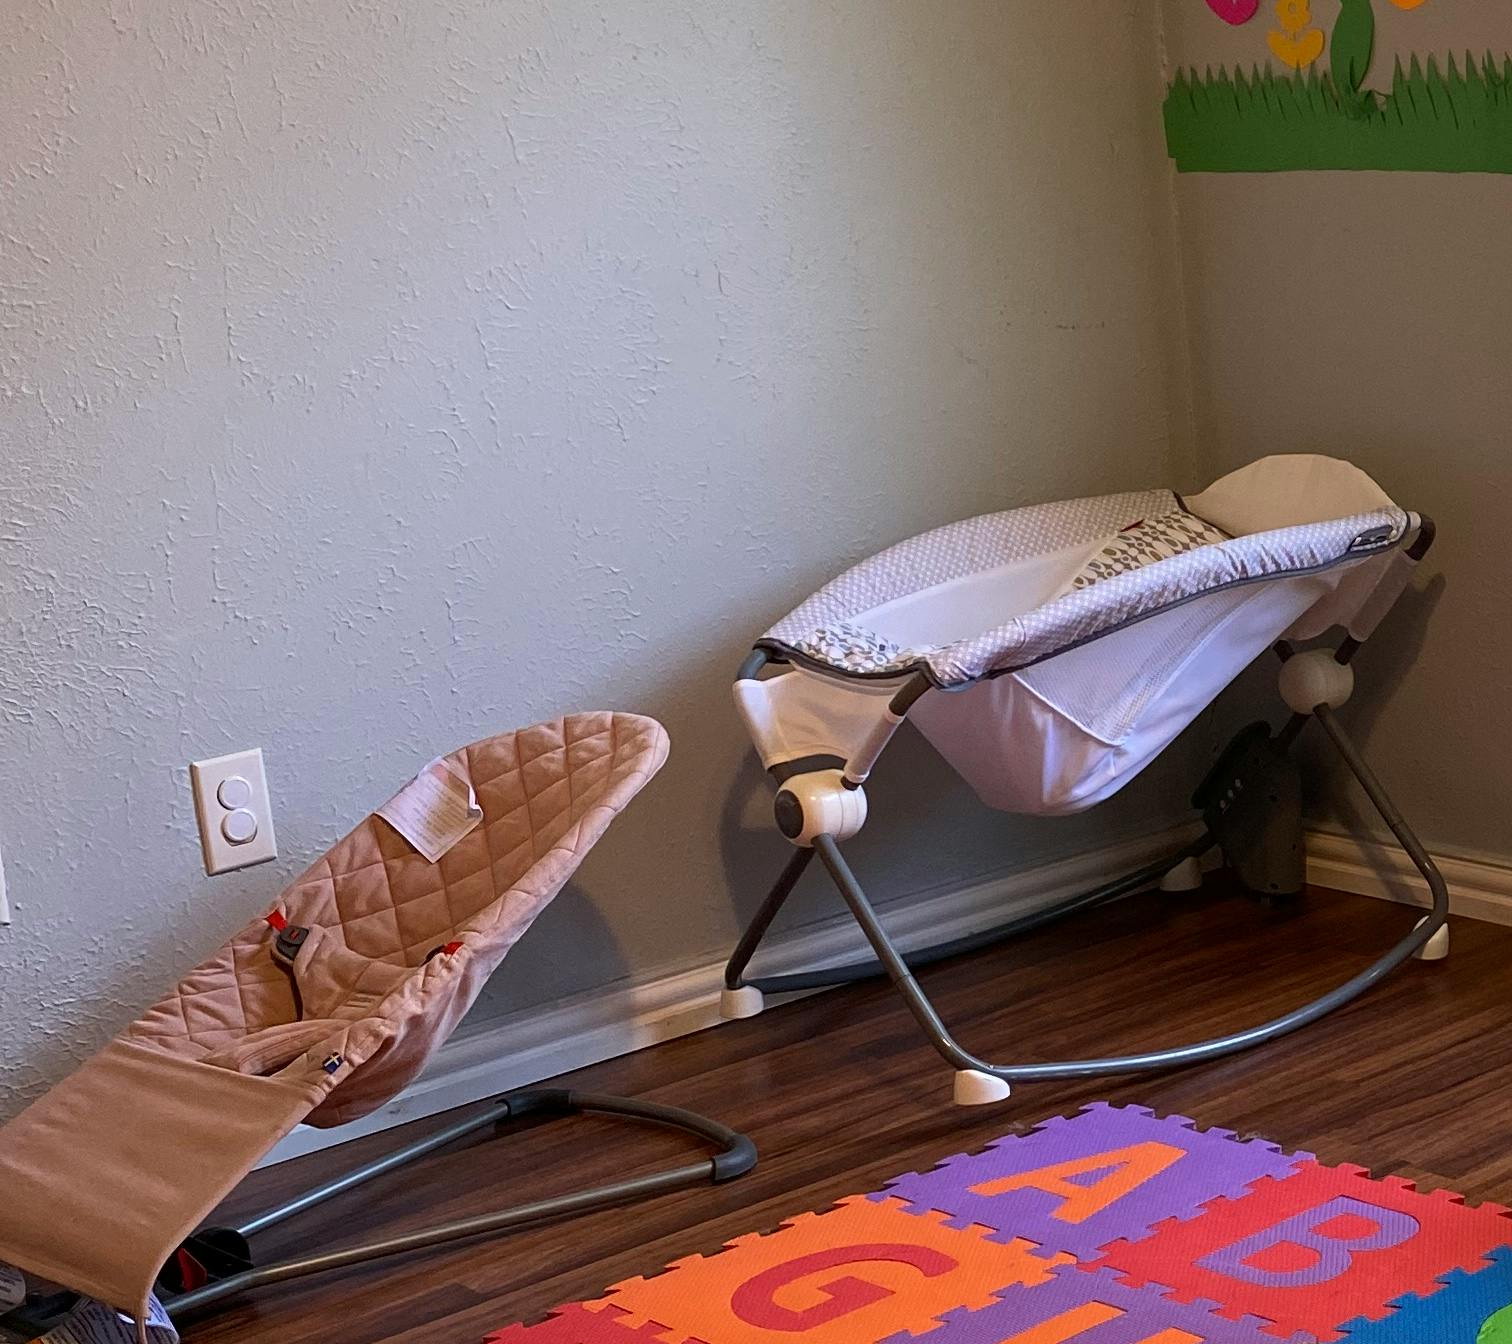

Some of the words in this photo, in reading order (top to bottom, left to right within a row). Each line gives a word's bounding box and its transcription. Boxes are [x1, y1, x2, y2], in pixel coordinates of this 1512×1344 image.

[967, 1140, 1186, 1225] A
[1193, 1195, 1420, 1288] B
[730, 1243, 957, 1334] G
